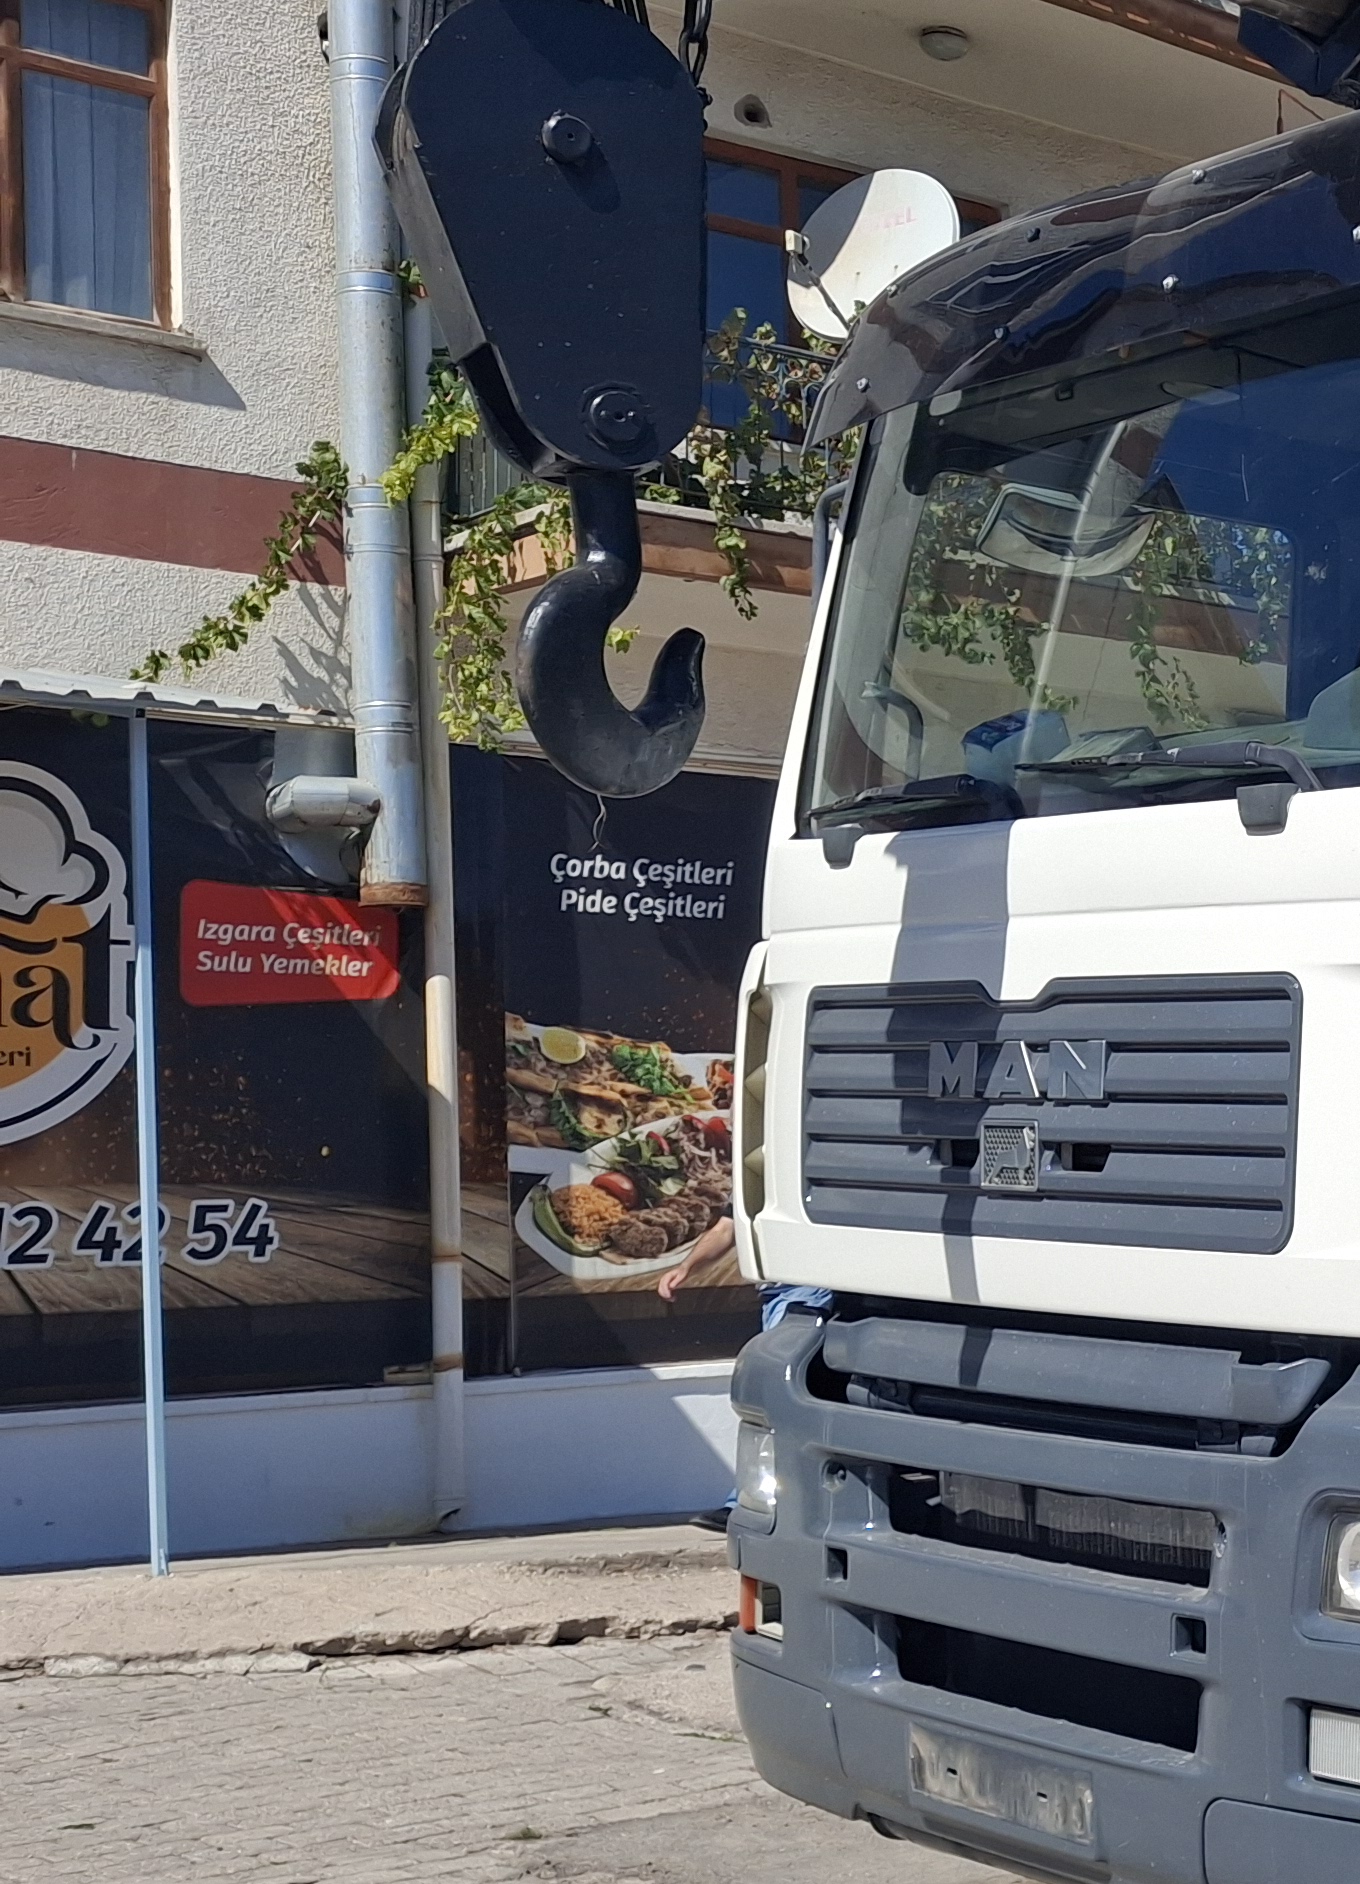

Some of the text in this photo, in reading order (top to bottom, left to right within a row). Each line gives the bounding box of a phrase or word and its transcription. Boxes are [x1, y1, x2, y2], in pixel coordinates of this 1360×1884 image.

[550, 853, 735, 888] Çorba Çeşitleri
[560, 887, 726, 923] Pide Çeşitleri
[197, 918, 382, 950] Izgara Çeşitleri
[196, 950, 373, 977] Sulu Yemekler
[927, 1039, 1106, 1100] MAN
[186, 1203, 275, 1261] 54
